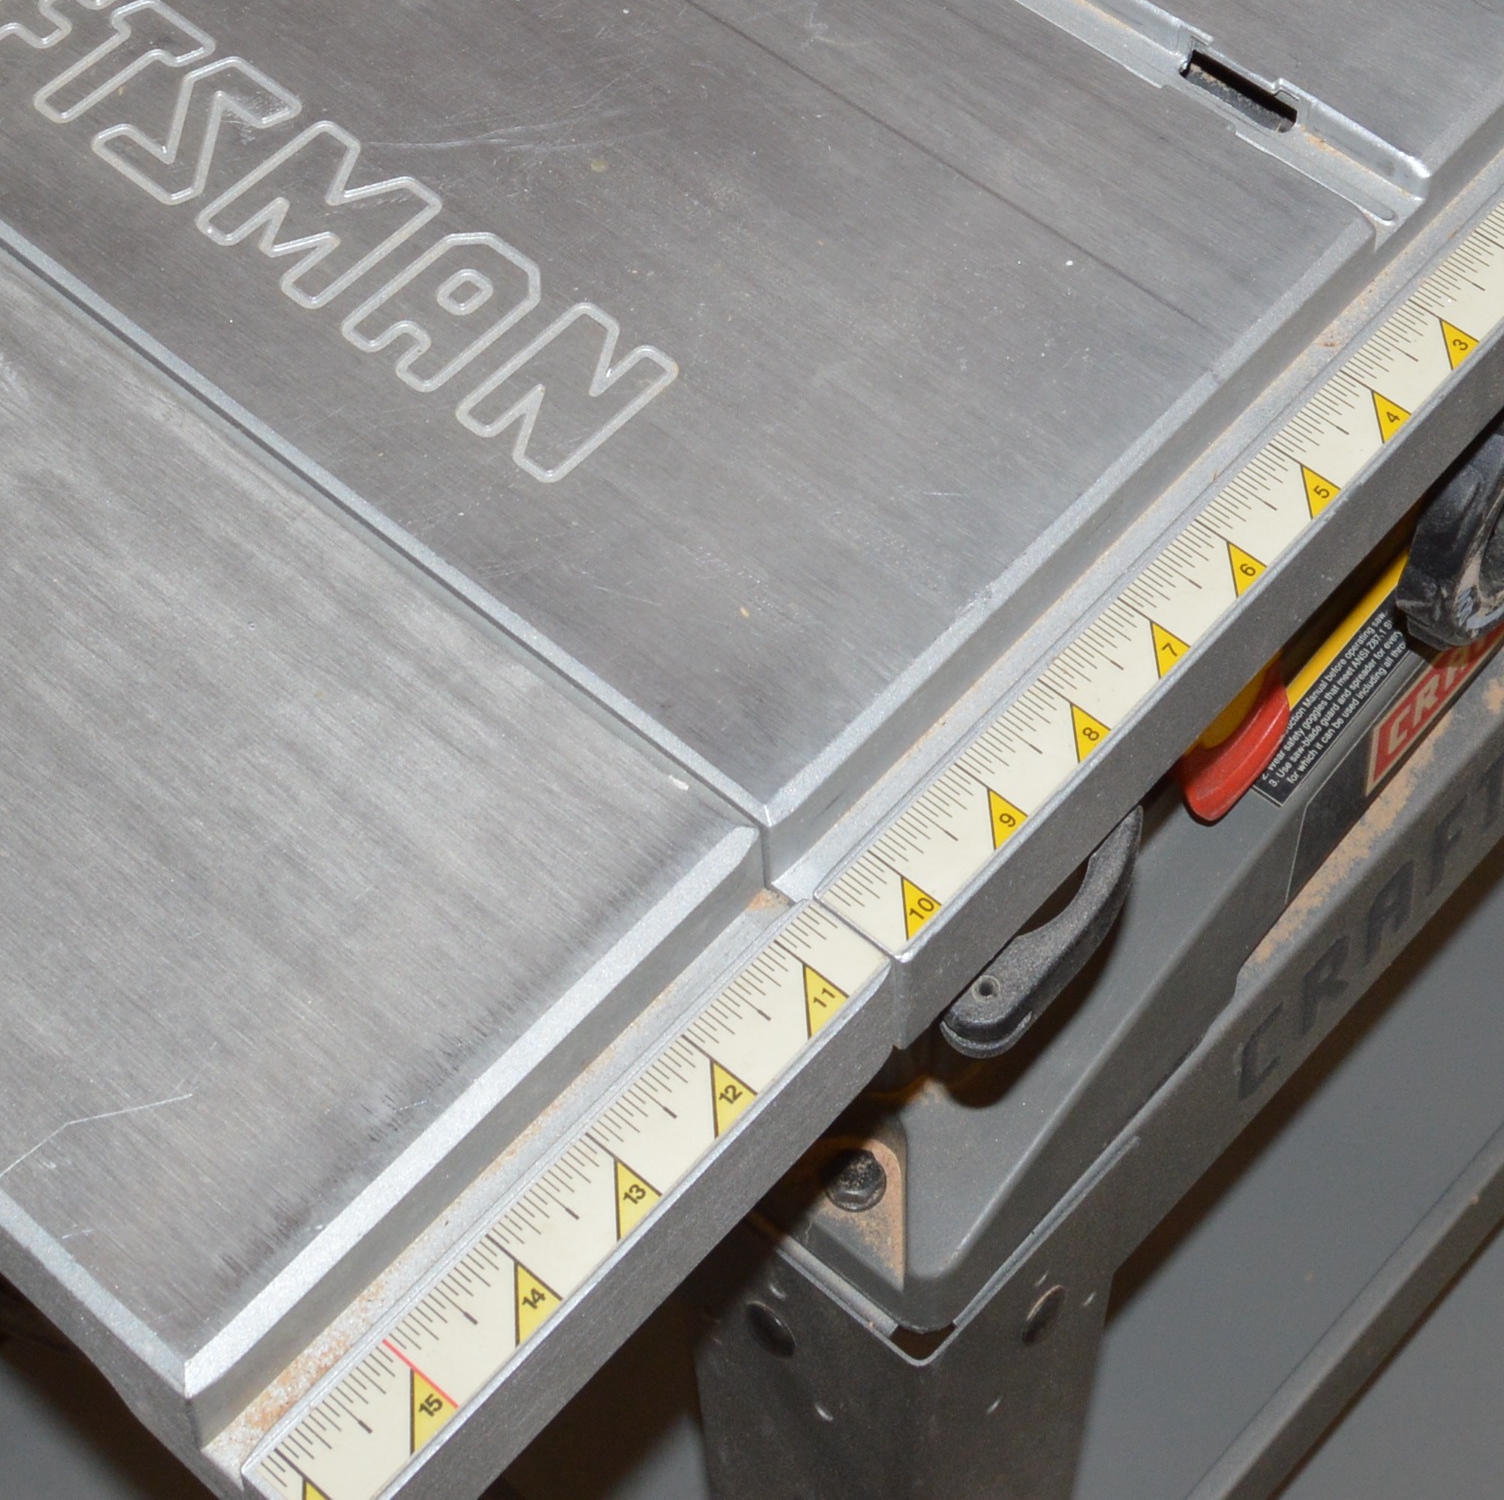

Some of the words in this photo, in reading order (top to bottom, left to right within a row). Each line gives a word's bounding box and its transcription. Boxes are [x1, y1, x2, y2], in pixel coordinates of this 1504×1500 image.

[1452, 337, 1469, 354] 3
[1384, 410, 1400, 425] 4
[1313, 484, 1330, 502] 5
[1239, 561, 1257, 580] 6
[1162, 642, 1179, 660] 7
[1286, 708, 1305, 732] uction
[1302, 683, 1329, 709] Manual
[1326, 660, 1347, 683] before
[1344, 624, 1376, 661] operating
[1373, 610, 1389, 628] saw.
[1283, 728, 1306, 753] safety
[1302, 700, 1328, 731] goggles
[1326, 686, 1341, 701] that
[1338, 668, 1356, 687] meet
[1352, 650, 1369, 669] ANSI
[1366, 628, 1387, 651] Z87.1
[1268, 777, 1280, 788] 3.
[1276, 761, 1293, 779] Use
[1292, 725, 1323, 764] saw-blade
[1319, 703, 1341, 727] guard
[1337, 689, 1352, 706] and
[1349, 658, 1377, 692] spreader
[1374, 647, 1386, 661] for
[1383, 630, 1403, 650] every
[1287, 771, 1300, 785] for
[1297, 749, 1318, 773] which
[1322, 727, 1337, 745] can
[1333, 717, 1345, 730] be
[1342, 698, 1361, 719] used
[1357, 665, 1388, 702] including
[1383, 655, 1395, 669] all
[1083, 725, 1100, 743] 8
[1000, 810, 1017, 830] 9
[908, 894, 936, 924] 10
[811, 985, 841, 1010] 11
[717, 1082, 745, 1107] 12
[622, 1182, 648, 1207] 13
[521, 1285, 548, 1313] 14
[418, 1392, 445, 1420] 15
